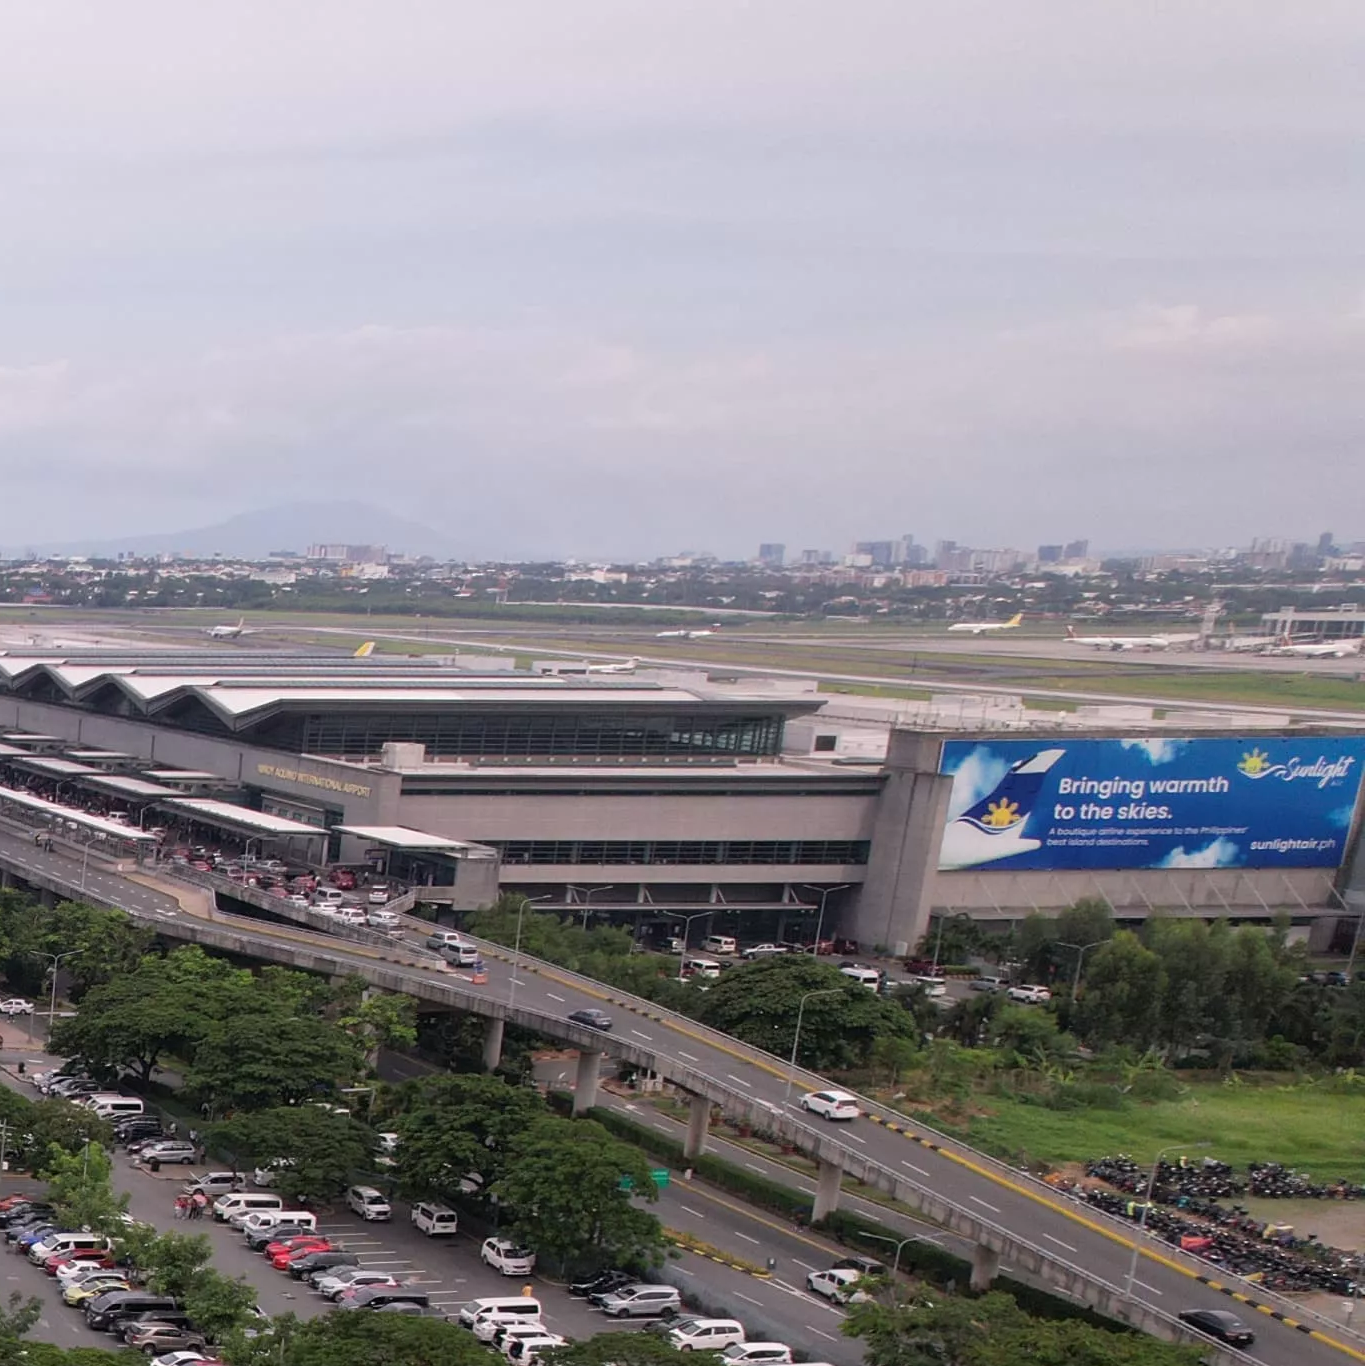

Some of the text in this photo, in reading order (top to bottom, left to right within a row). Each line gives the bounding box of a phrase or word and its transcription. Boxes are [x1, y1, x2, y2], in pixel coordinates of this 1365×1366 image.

[1277, 756, 1356, 789] Sunlight
[1059, 777, 1229, 799] Bringing warmth
[1053, 802, 1173, 820] to the skies.
[1057, 827, 1097, 837] boutique
[1099, 827, 1125, 836] airline
[1126, 827, 1173, 837] experience
[1173, 827, 1183, 835] to
[1183, 827, 1199, 835] the
[1046, 838, 1066, 846] best
[1067, 838, 1096, 846] island
[1250, 839, 1337, 853] sunlightair.ph
